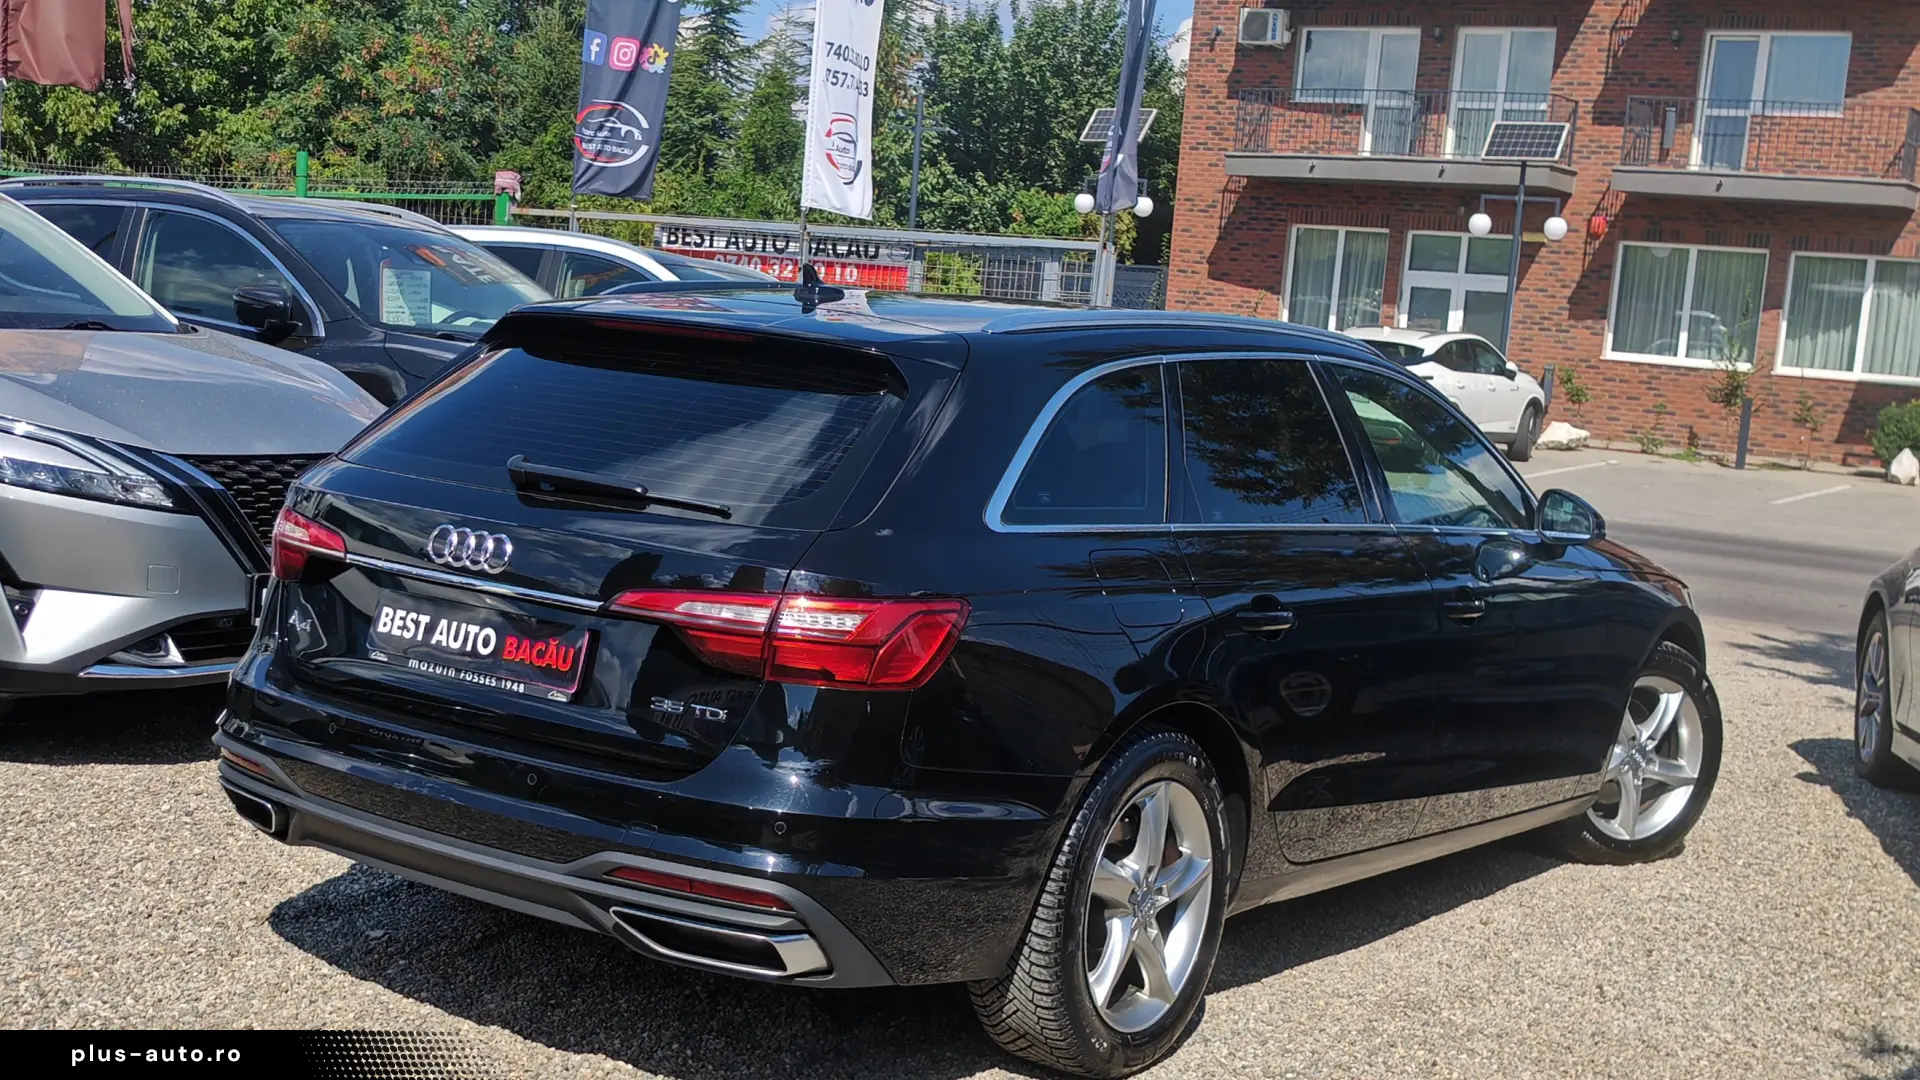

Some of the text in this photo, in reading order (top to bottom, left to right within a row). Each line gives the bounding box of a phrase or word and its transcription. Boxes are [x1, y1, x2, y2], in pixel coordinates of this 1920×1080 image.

[286, 609, 313, 632] A4
[377, 606, 576, 672] BEST AUTO BACĂU
[459, 669, 498, 688] FOSSES
[501, 679, 525, 693] 1948
